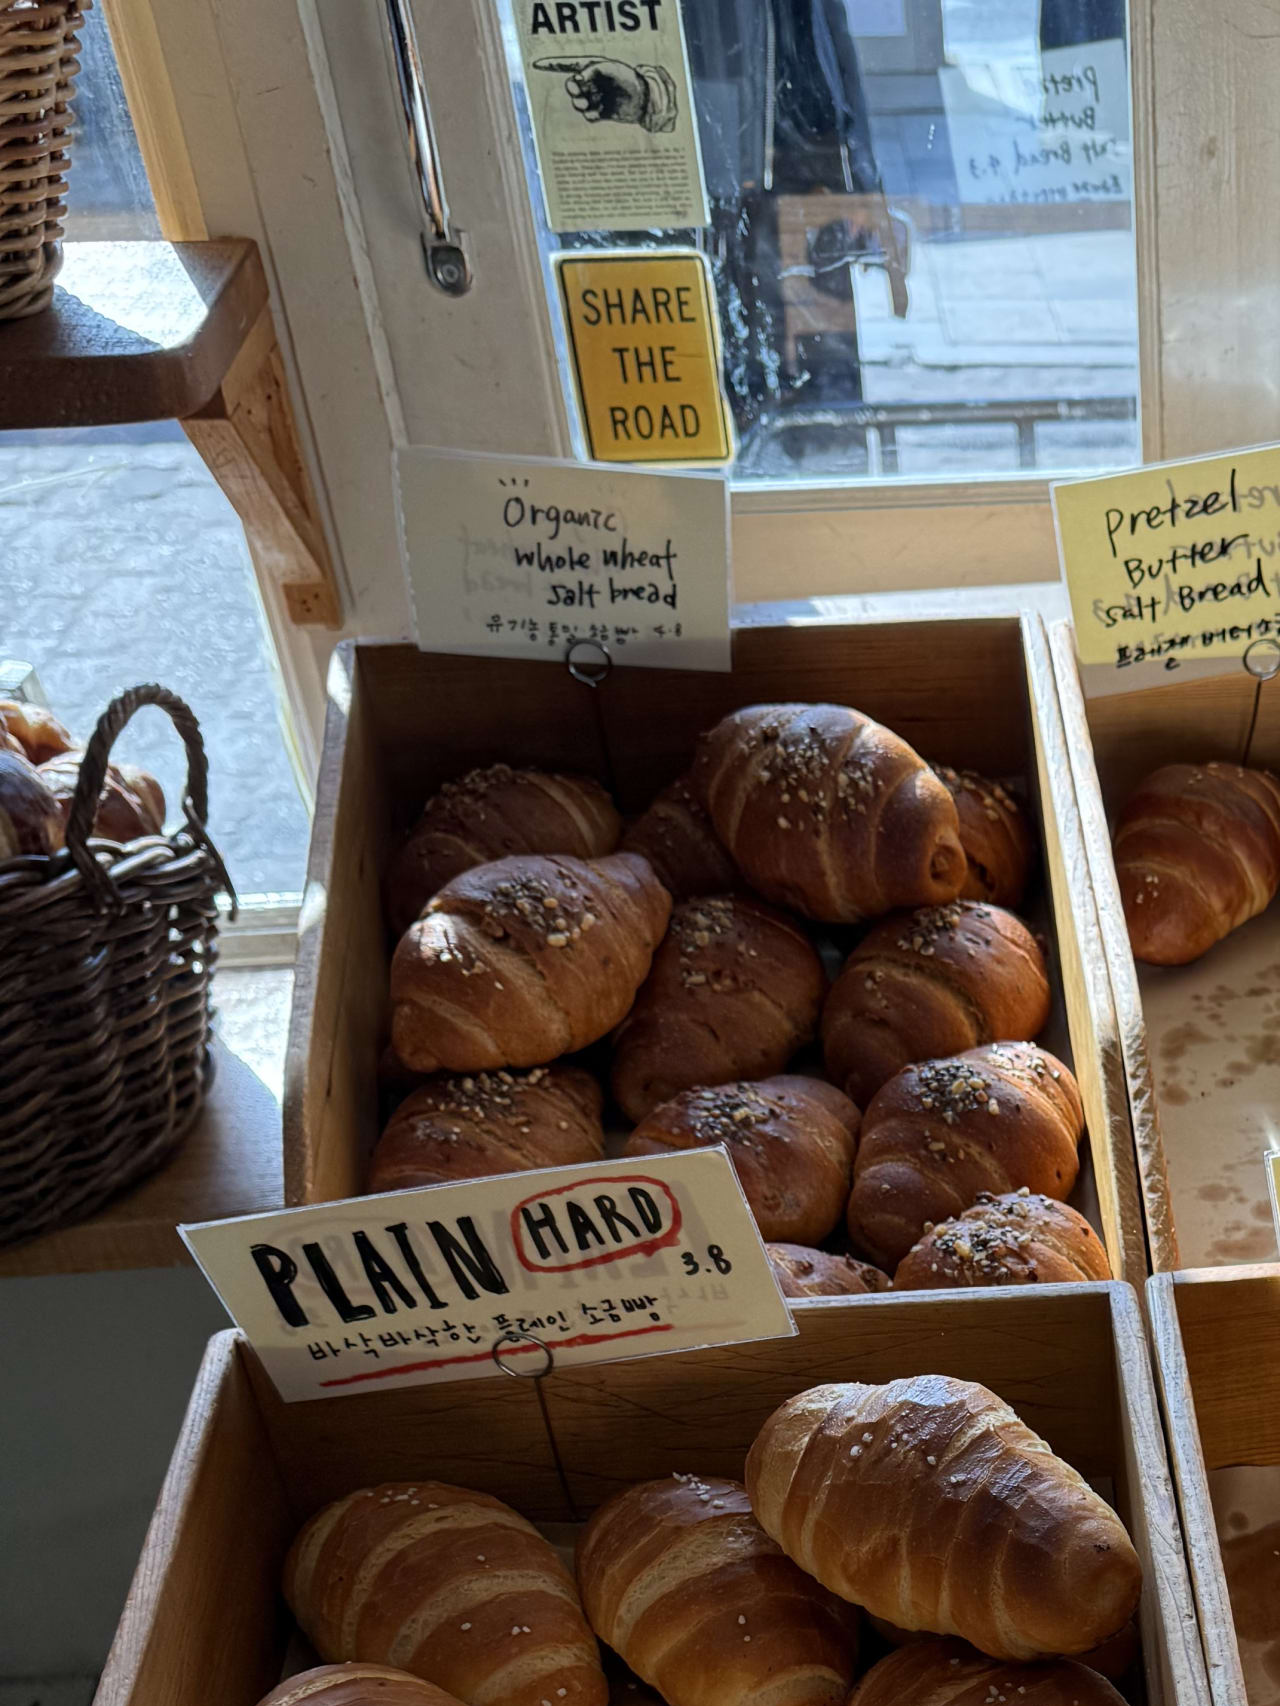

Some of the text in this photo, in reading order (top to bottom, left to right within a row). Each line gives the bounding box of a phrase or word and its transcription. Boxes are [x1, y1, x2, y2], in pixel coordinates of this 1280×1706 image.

[531, 0, 662, 35] ARTIST
[581, 286, 698, 327] SHARE
[612, 346, 682, 385] THE
[609, 404, 702, 442] ROAD
[503, 497, 619, 540] Organic
[602, 538, 678, 581] wheat
[1124, 533, 1250, 589] Butter
[608, 577, 677, 610] bread
[1178, 558, 1271, 612] Bread
[250, 1186, 733, 1328] PLAIN HARD 3.8
[306, 1295, 660, 1361] 바삭바삭한 플레인 소금빵
